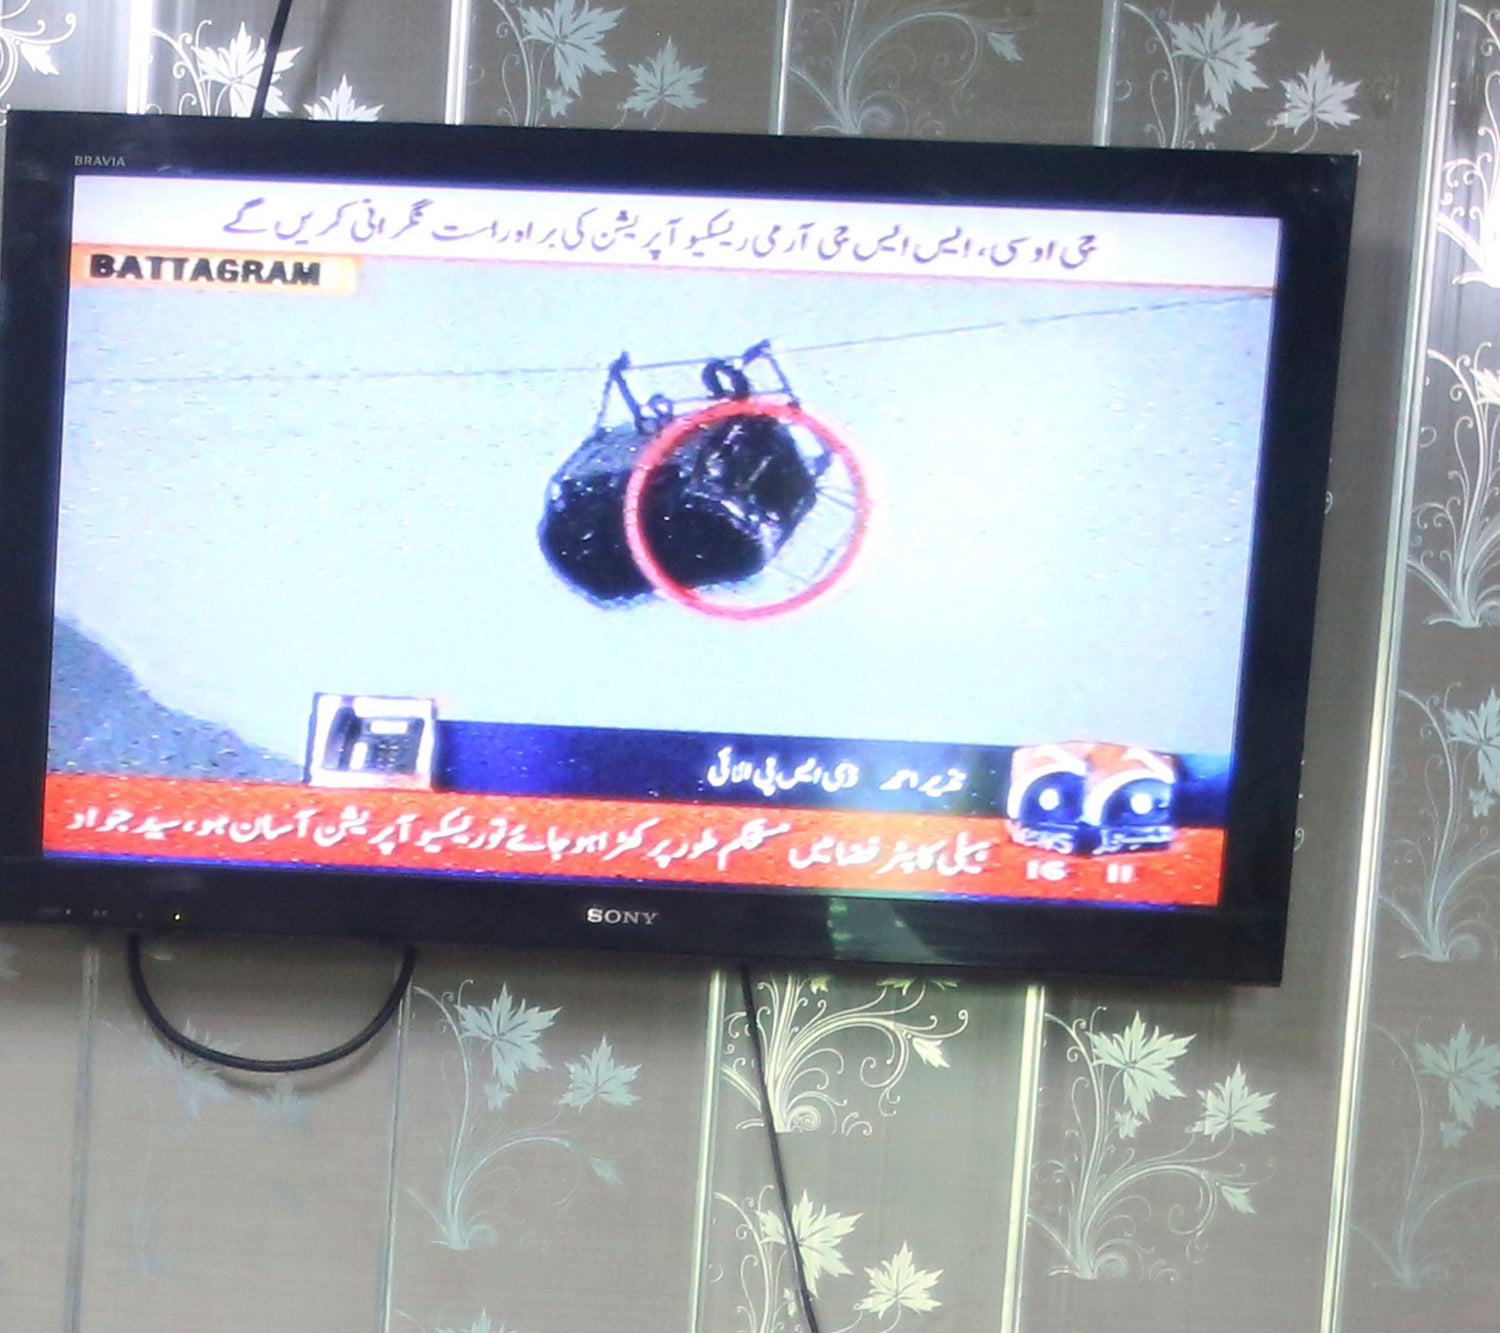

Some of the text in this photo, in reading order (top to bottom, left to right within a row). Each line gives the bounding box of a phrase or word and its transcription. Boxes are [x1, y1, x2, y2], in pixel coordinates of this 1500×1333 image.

[74, 155, 126, 168] BRAVIA
[222, 196, 269, 234] گے
[561, 206, 600, 250] کی
[817, 223, 850, 261] جی
[852, 223, 910, 262] ایس
[912, 225, 971, 264] ایس
[1030, 240, 1056, 263] او
[1059, 234, 1098, 270] جی
[89, 252, 322, 287] BATTAGRAM
[1025, 859, 1069, 882] 16
[586, 907, 659, 926] SONY
